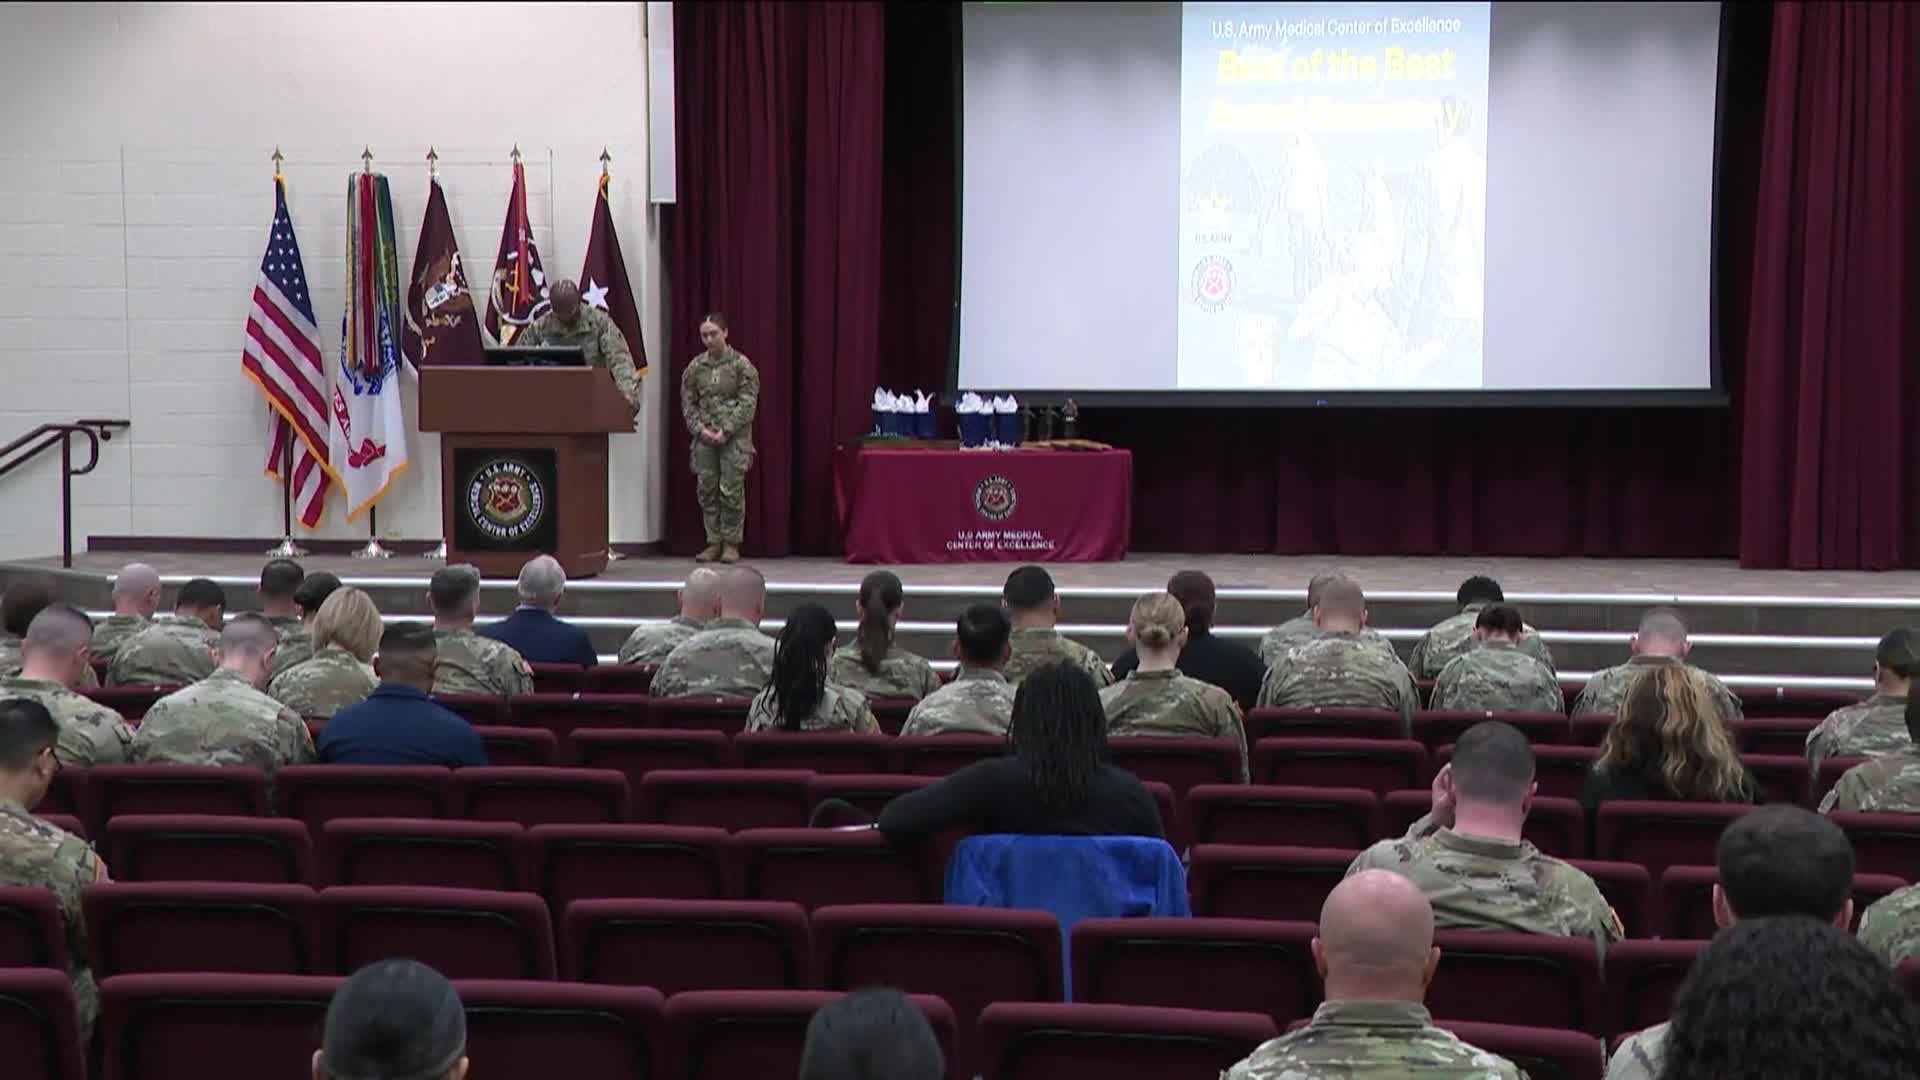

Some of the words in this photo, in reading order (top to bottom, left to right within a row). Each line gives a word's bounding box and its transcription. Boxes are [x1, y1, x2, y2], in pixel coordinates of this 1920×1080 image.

[1238, 19, 1273, 41] Army
[1274, 17, 1325, 38] Medical
[1327, 17, 1371, 35] Center
[1374, 16, 1389, 35] of
[1390, 15, 1462, 34] Excellence
[502, 463, 526, 477] ARMY
[975, 531, 1001, 540] ARMY
[1003, 531, 1043, 540] MEDICAL
[946, 541, 982, 551] CENTER
[983, 541, 995, 550] OF
[997, 541, 1056, 550] EXCELLENCE
